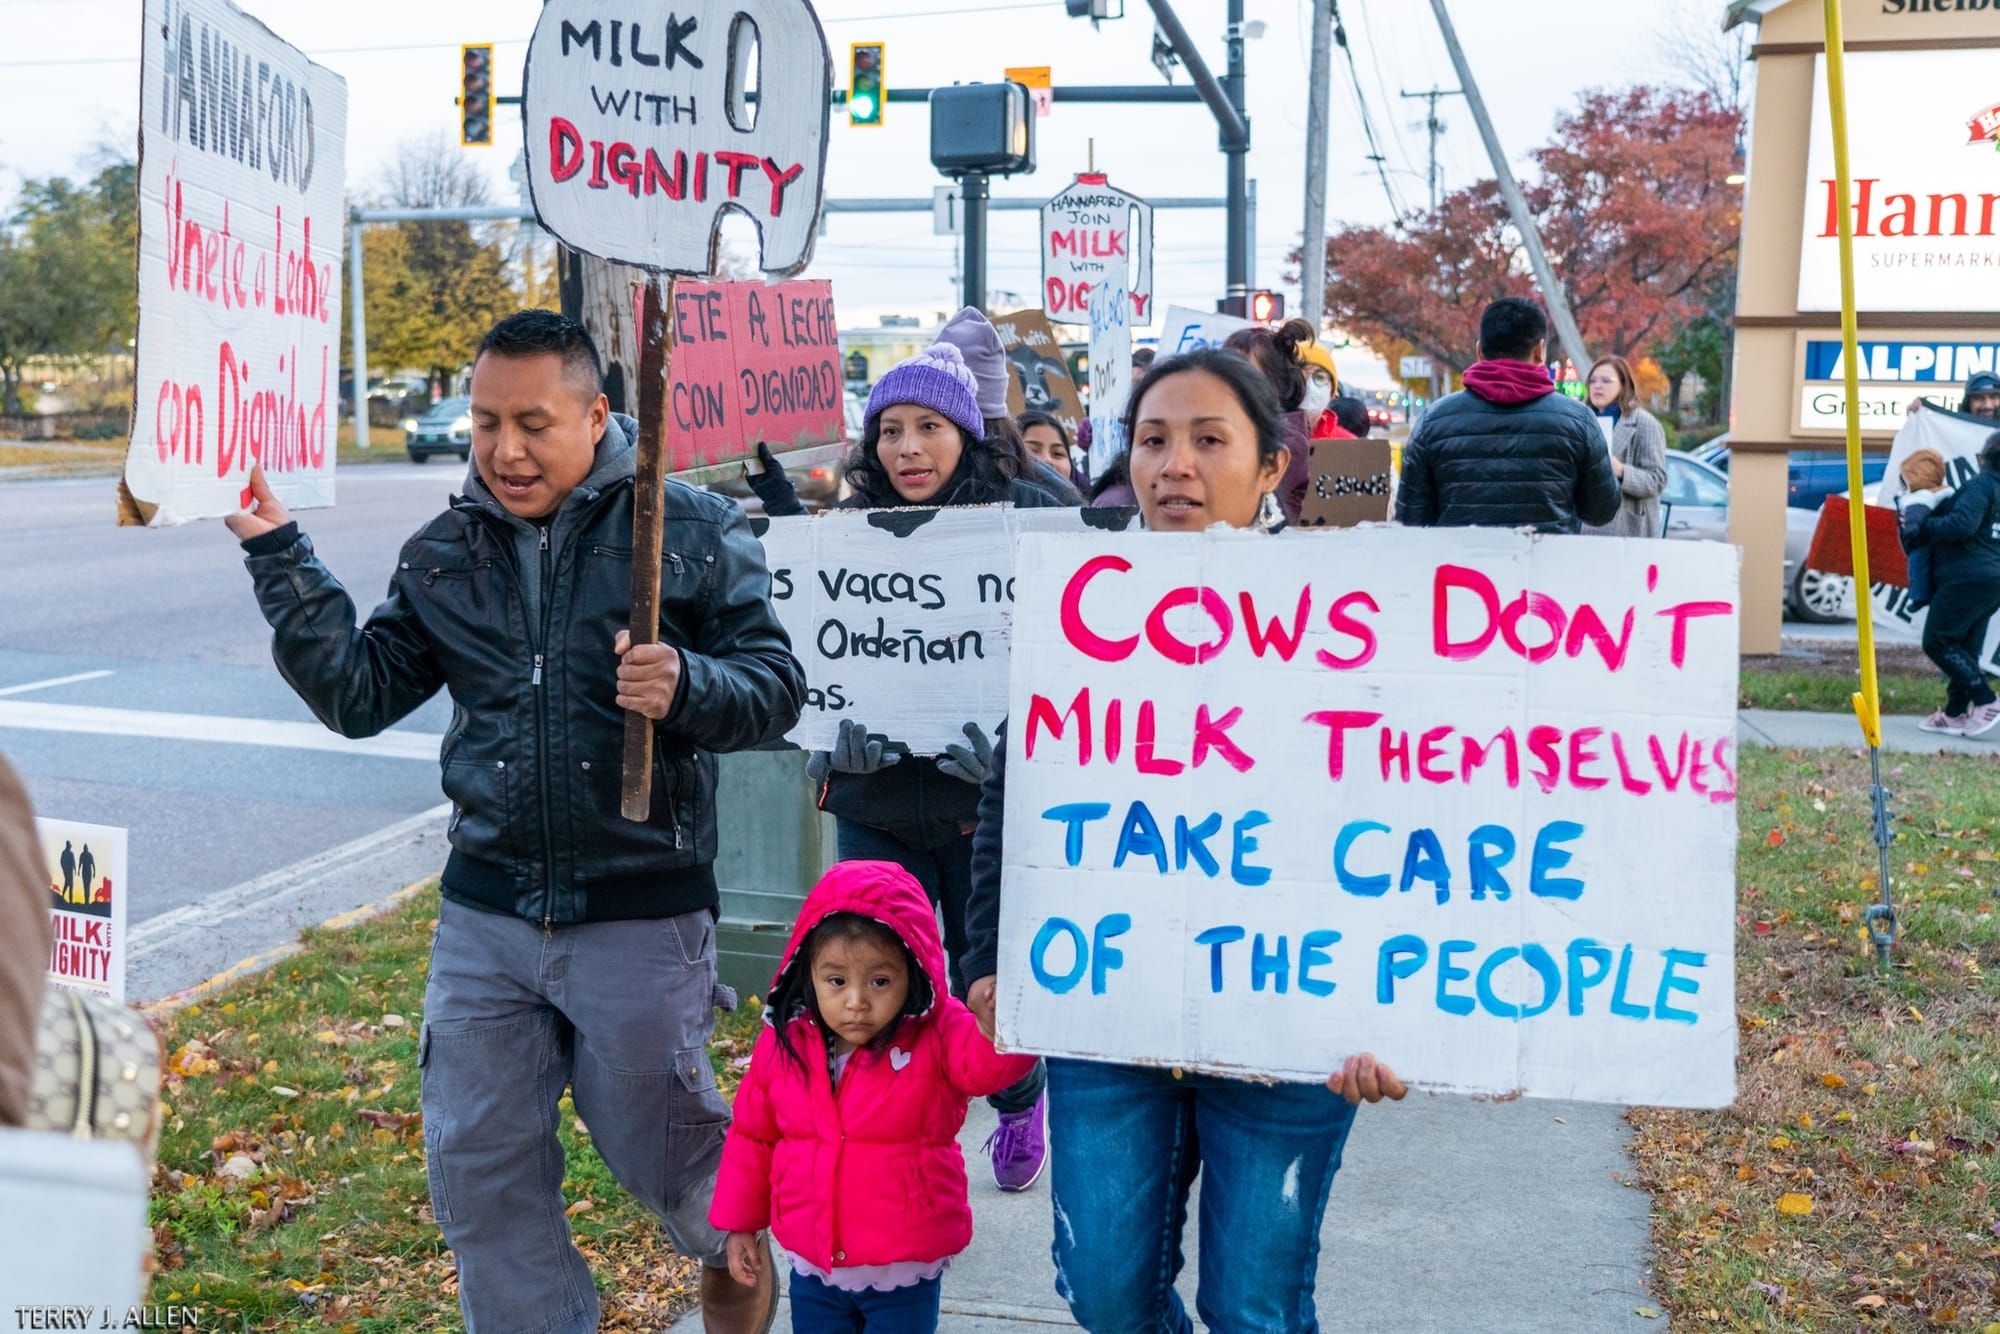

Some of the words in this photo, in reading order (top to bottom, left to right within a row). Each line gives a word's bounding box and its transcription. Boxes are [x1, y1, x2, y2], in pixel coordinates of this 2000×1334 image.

[561, 12, 703, 70] MILK
[161, 0, 314, 194] HANNAFORD
[591, 85, 697, 126] WITH
[550, 116, 804, 218] DIGNITY
[1051, 194, 1125, 212] HANNAFORD
[1067, 211, 1111, 225] JOIN
[274, 205, 332, 324] Leche
[1051, 228, 1126, 258] MILK
[1070, 261, 1105, 272] WITH
[1871, 252, 2000, 268] SUPERMARK
[749, 290, 770, 347] A
[778, 292, 838, 348] LECHE
[1047, 277, 1149, 317] DIGY
[1830, 345, 2000, 381] ALPIN
[157, 379, 204, 465] con
[673, 381, 724, 432] CON
[741, 360, 836, 416] DIGNIDAD
[818, 568, 946, 610] vacas
[1060, 555, 1380, 670] COWS
[1433, 564, 1733, 672] DON'T
[817, 616, 985, 664] Ordeñan
[1025, 687, 1255, 776] MILK
[1301, 710, 1737, 803] THEMSELVES
[1041, 800, 1273, 886] TAKE
[1333, 820, 1585, 905] CARE
[46, 941, 111, 982] IGNITY
[1030, 913, 1131, 996] OF
[1194, 925, 1342, 997] THE
[1376, 933, 1708, 1025] PEOPLE
